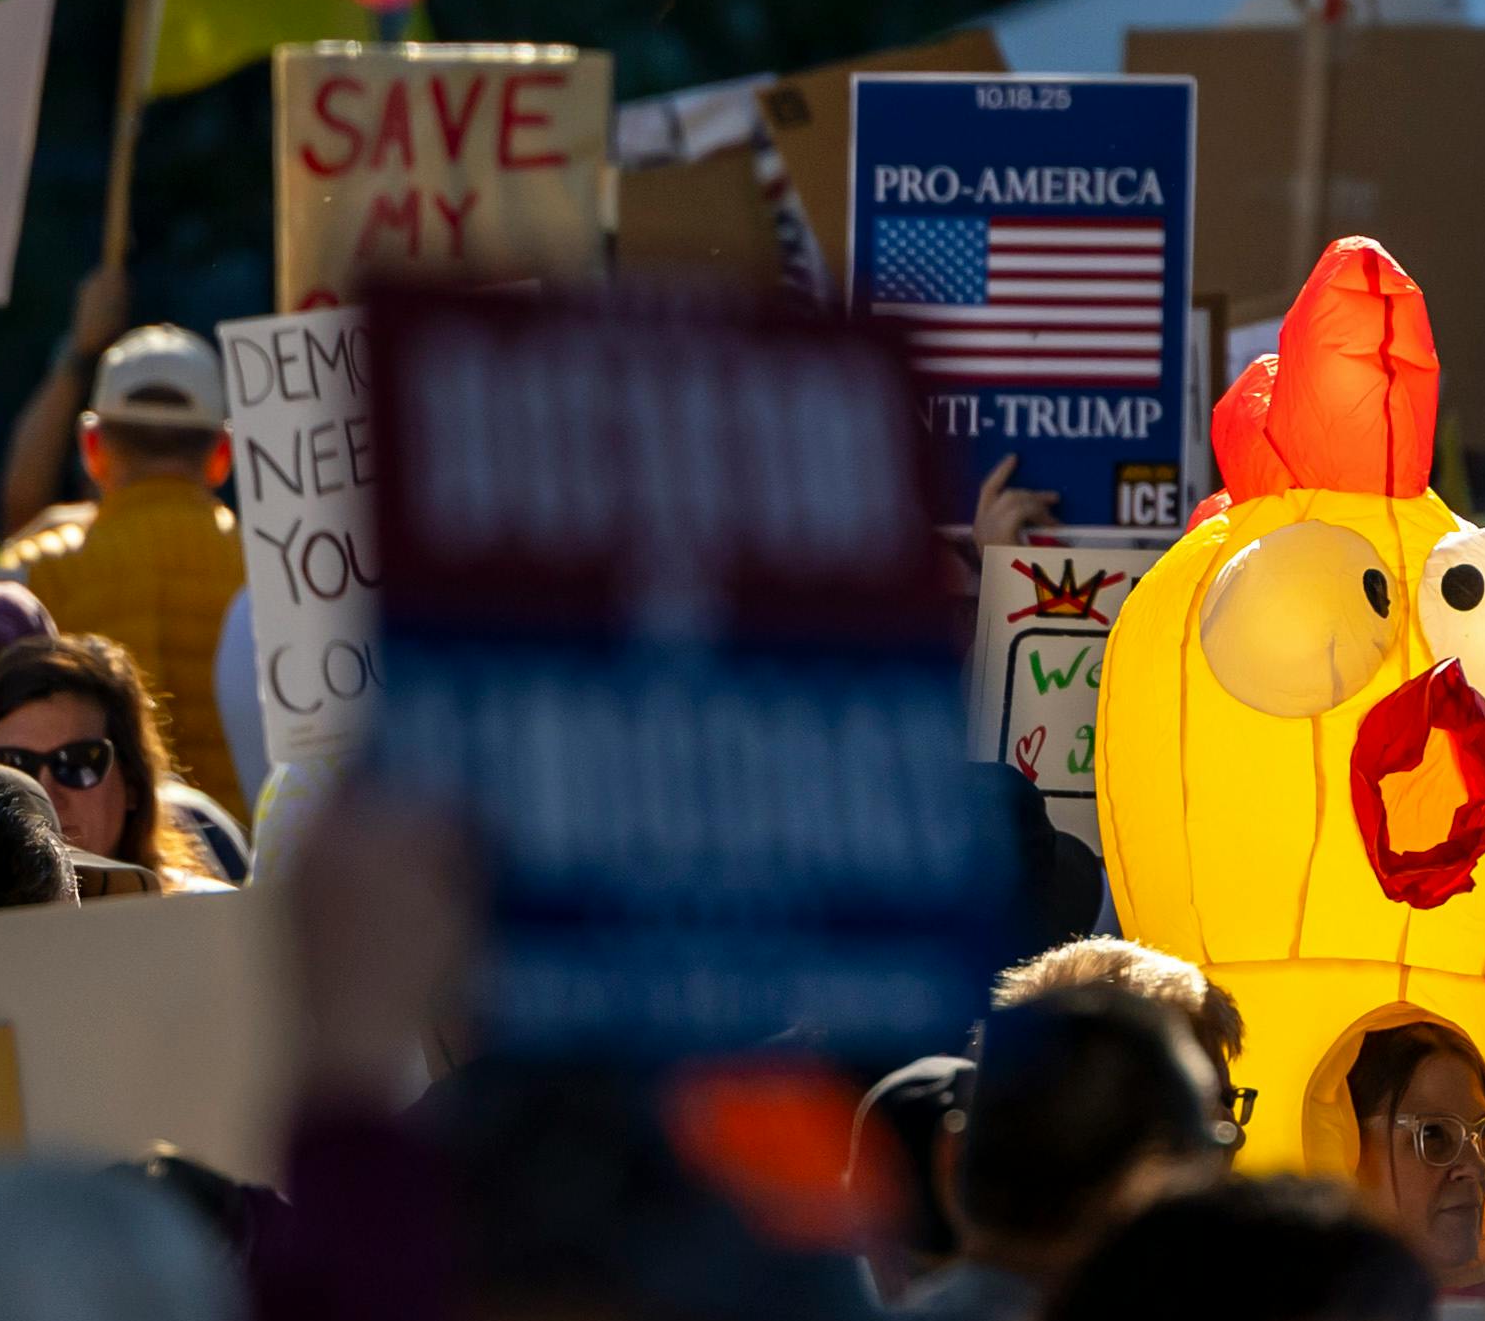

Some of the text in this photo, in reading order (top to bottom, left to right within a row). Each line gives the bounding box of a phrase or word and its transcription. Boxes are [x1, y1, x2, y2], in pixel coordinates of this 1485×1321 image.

[975, 85, 1073, 111] 10.18.25
[298, 69, 571, 179] SAVE
[873, 164, 1165, 206] PRO-AMERICA
[351, 186, 480, 264] MY
[919, 395, 1165, 439] NTI-TRUMP
[1118, 483, 1177, 524] ICE
